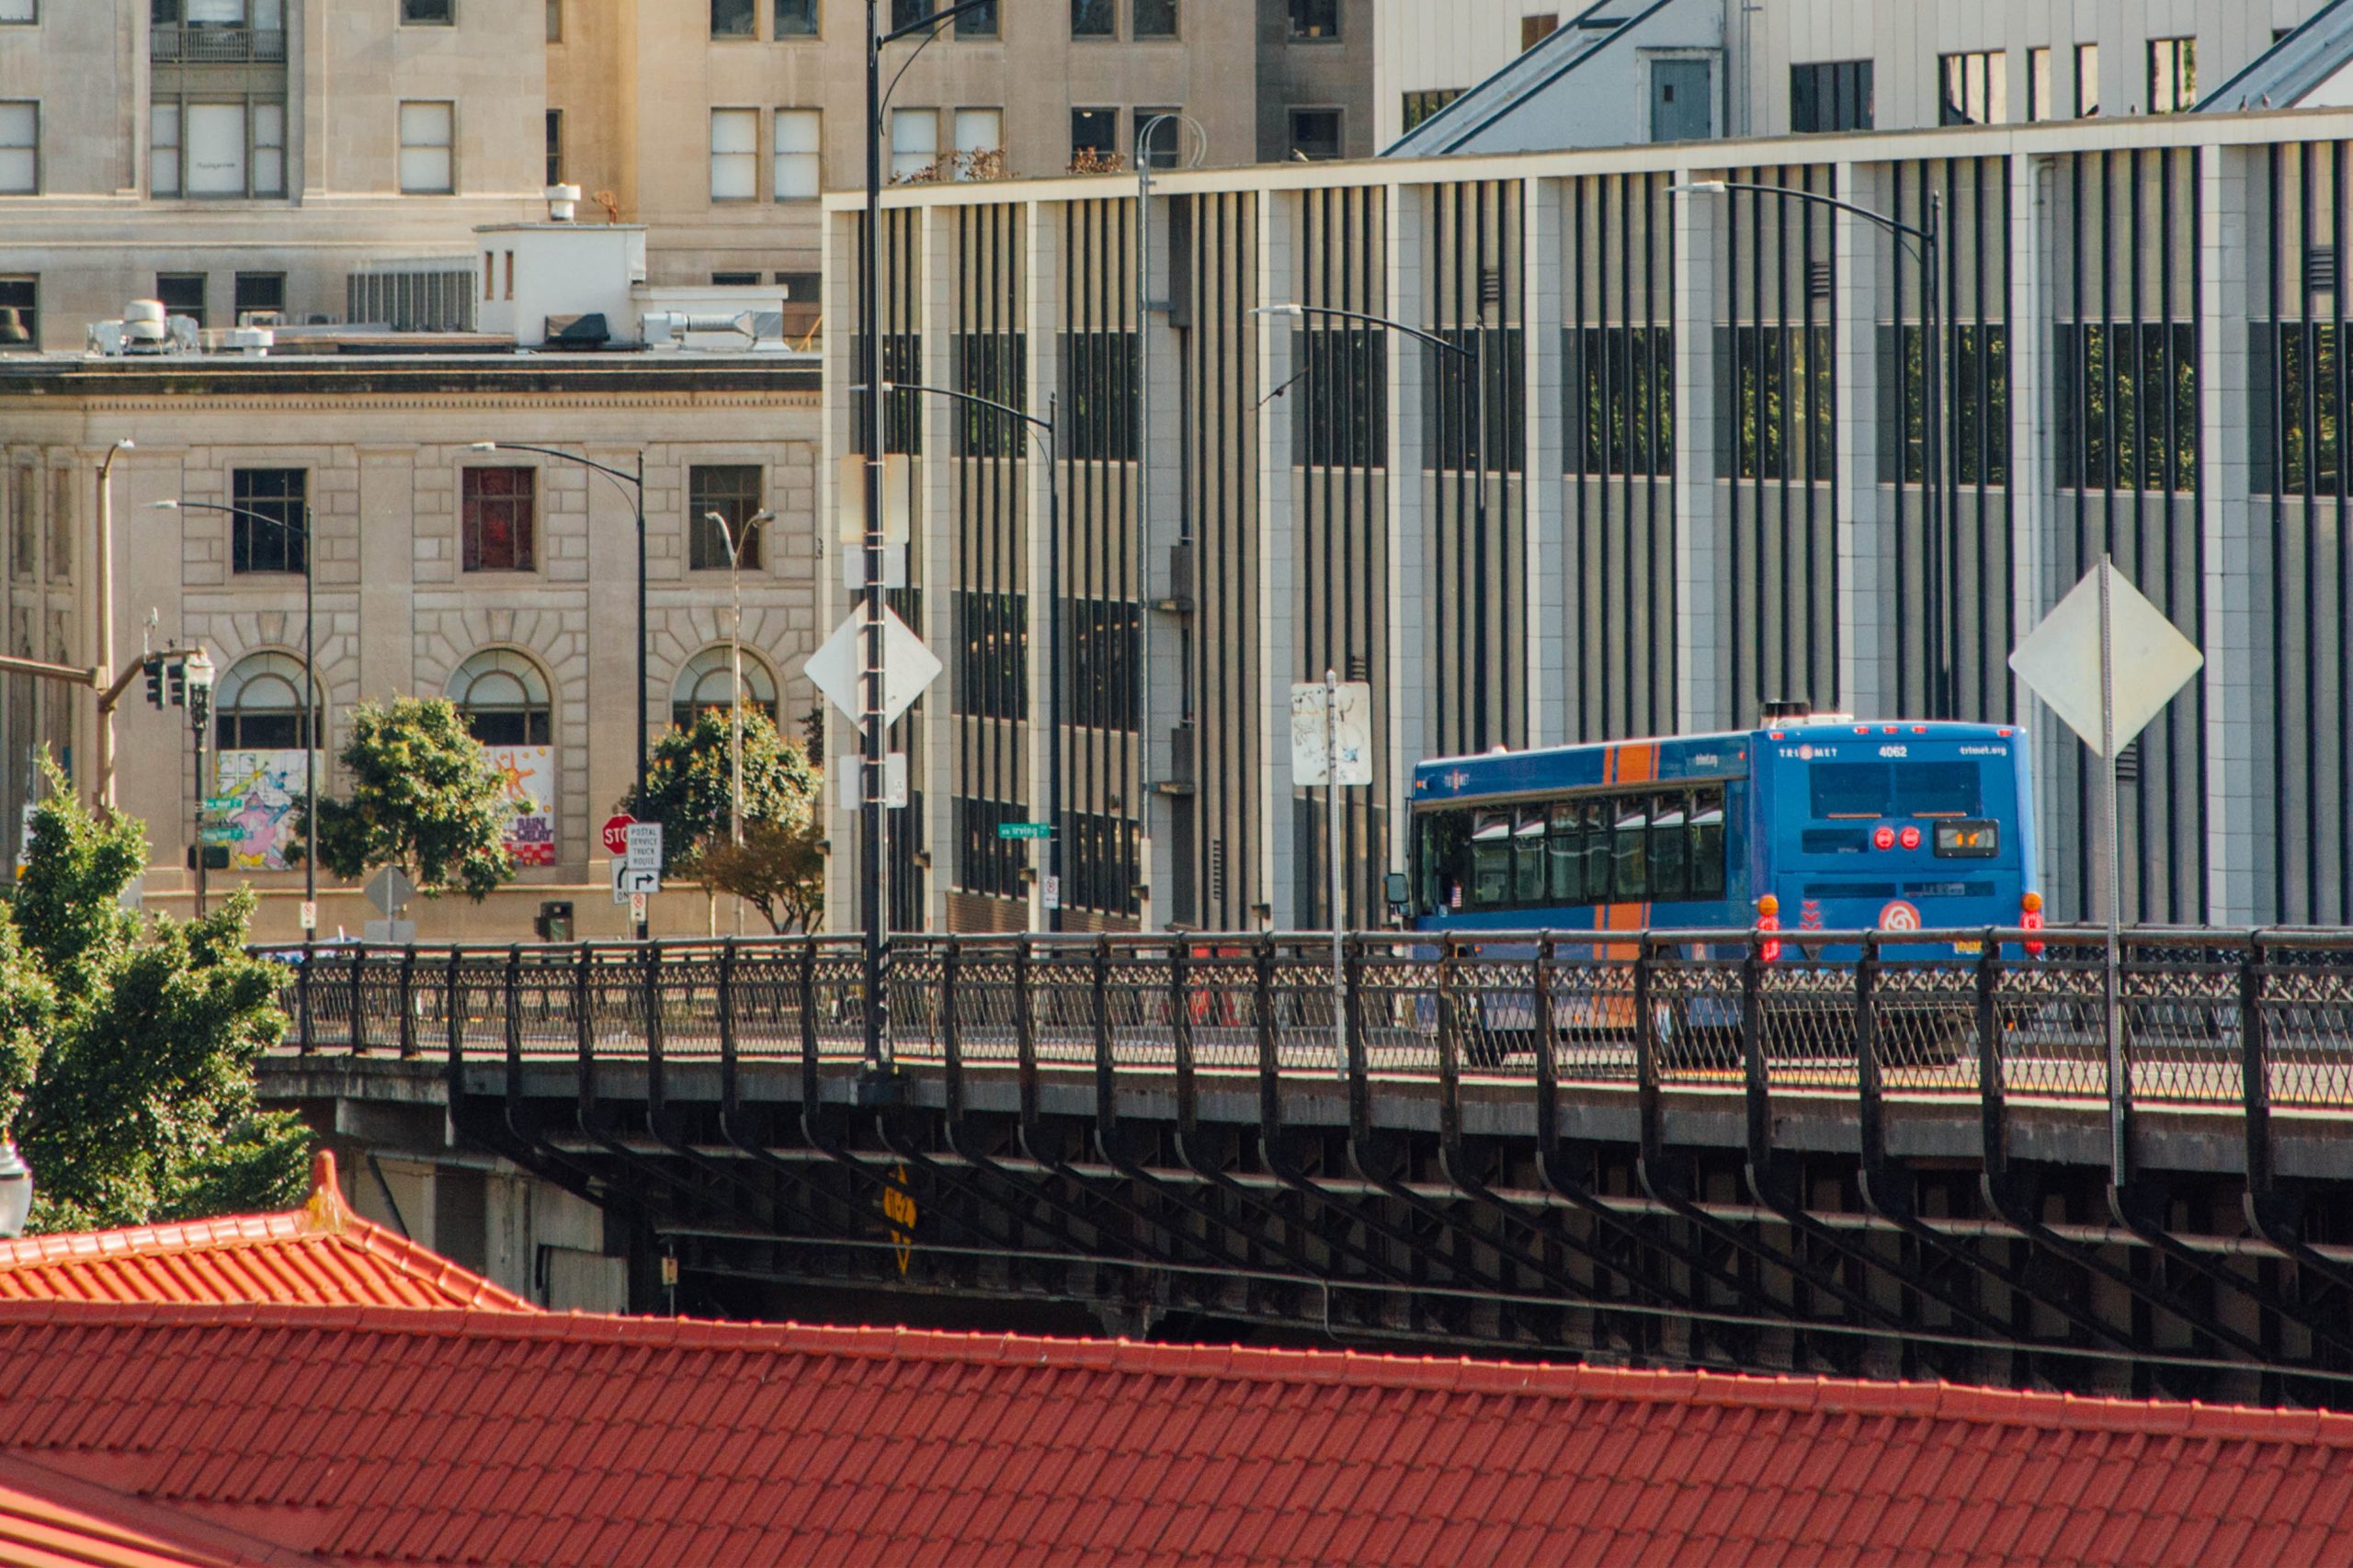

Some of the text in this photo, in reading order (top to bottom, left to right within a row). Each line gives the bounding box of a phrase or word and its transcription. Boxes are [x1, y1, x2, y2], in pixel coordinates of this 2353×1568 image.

[1879, 745, 1908, 757] 4062
[1960, 745, 2007, 756] trimet.org
[605, 828, 627, 844] STO
[631, 827, 656, 835] POSTAL
[1012, 826, 1038, 837] Irving
[630, 837, 657, 846] SERVICE
[632, 847, 655, 856] TRUCK
[632, 857, 655, 866] ROUTE
